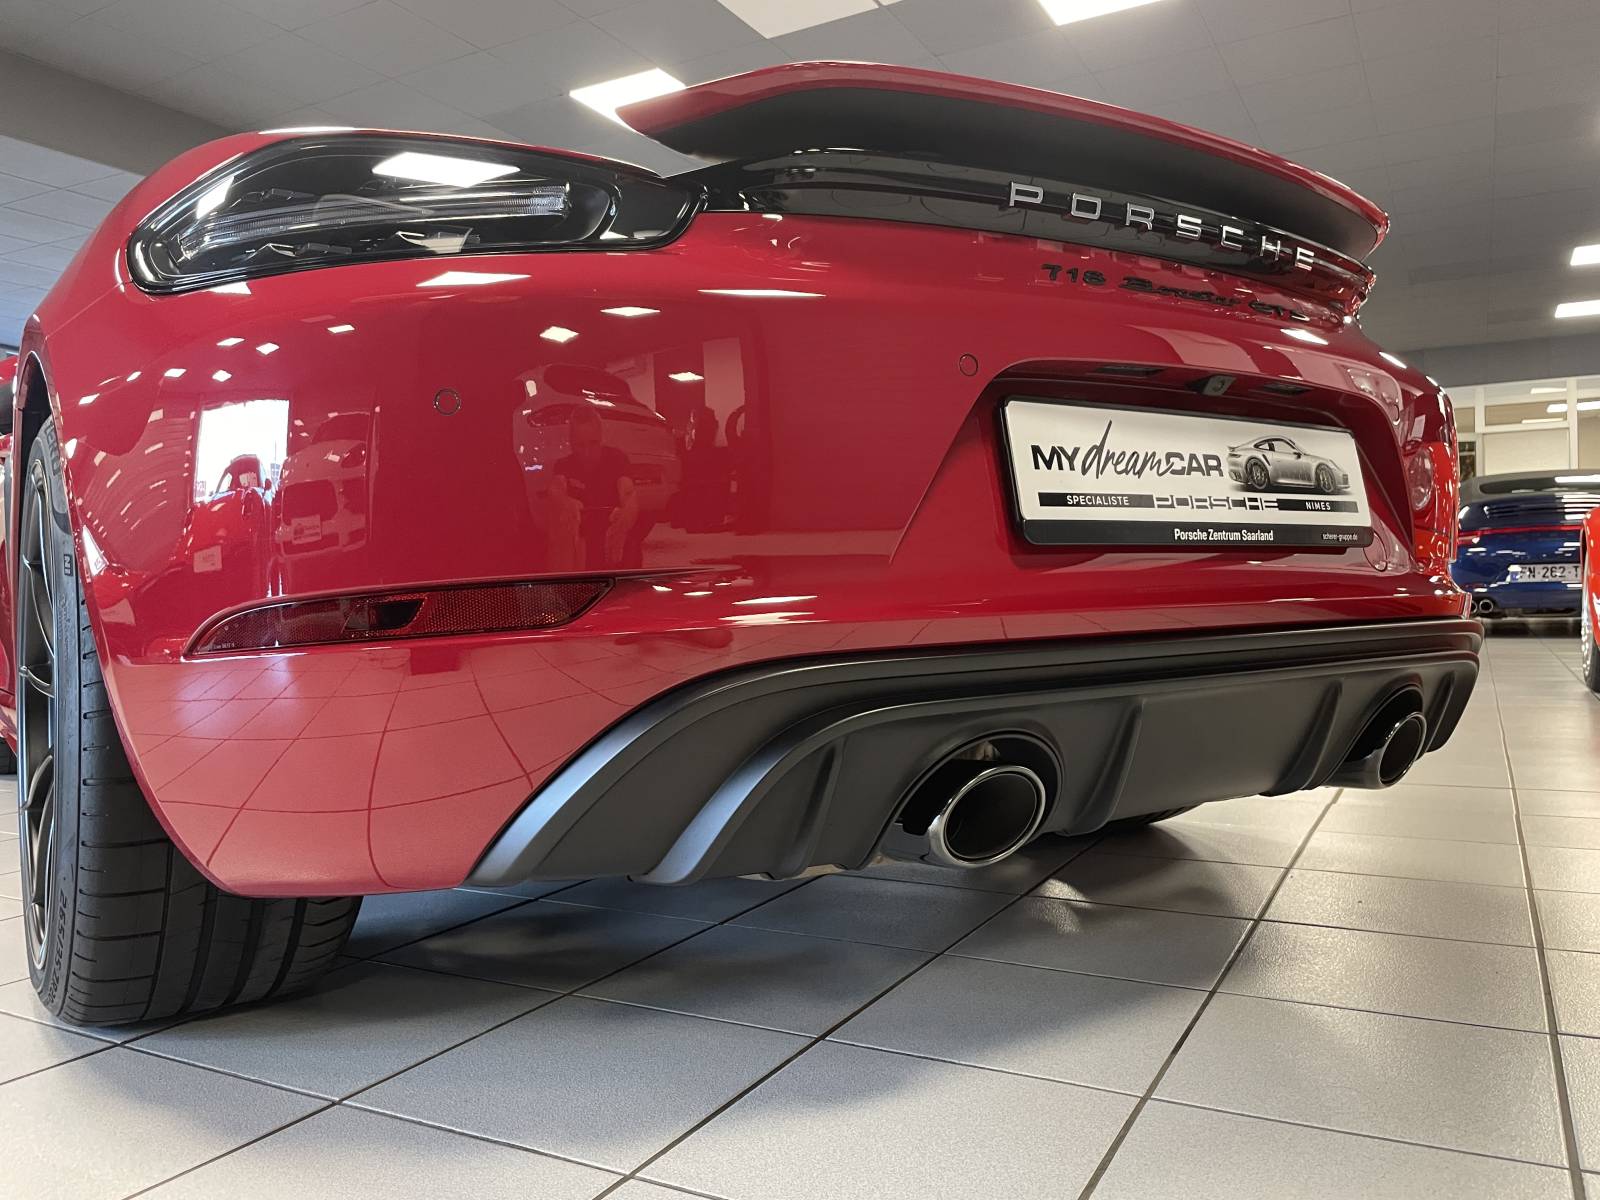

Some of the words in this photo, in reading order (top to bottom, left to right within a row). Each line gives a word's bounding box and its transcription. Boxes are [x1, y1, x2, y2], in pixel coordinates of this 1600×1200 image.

[1008, 180, 1315, 272] PORSCHE
[1066, 494, 1130, 506] SPECIALISTE
[1305, 501, 1332, 511] NIMES
[1174, 528, 1208, 541] Porsche
[1208, 529, 1241, 541] Zentrum
[1242, 529, 1274, 541] Saarland
